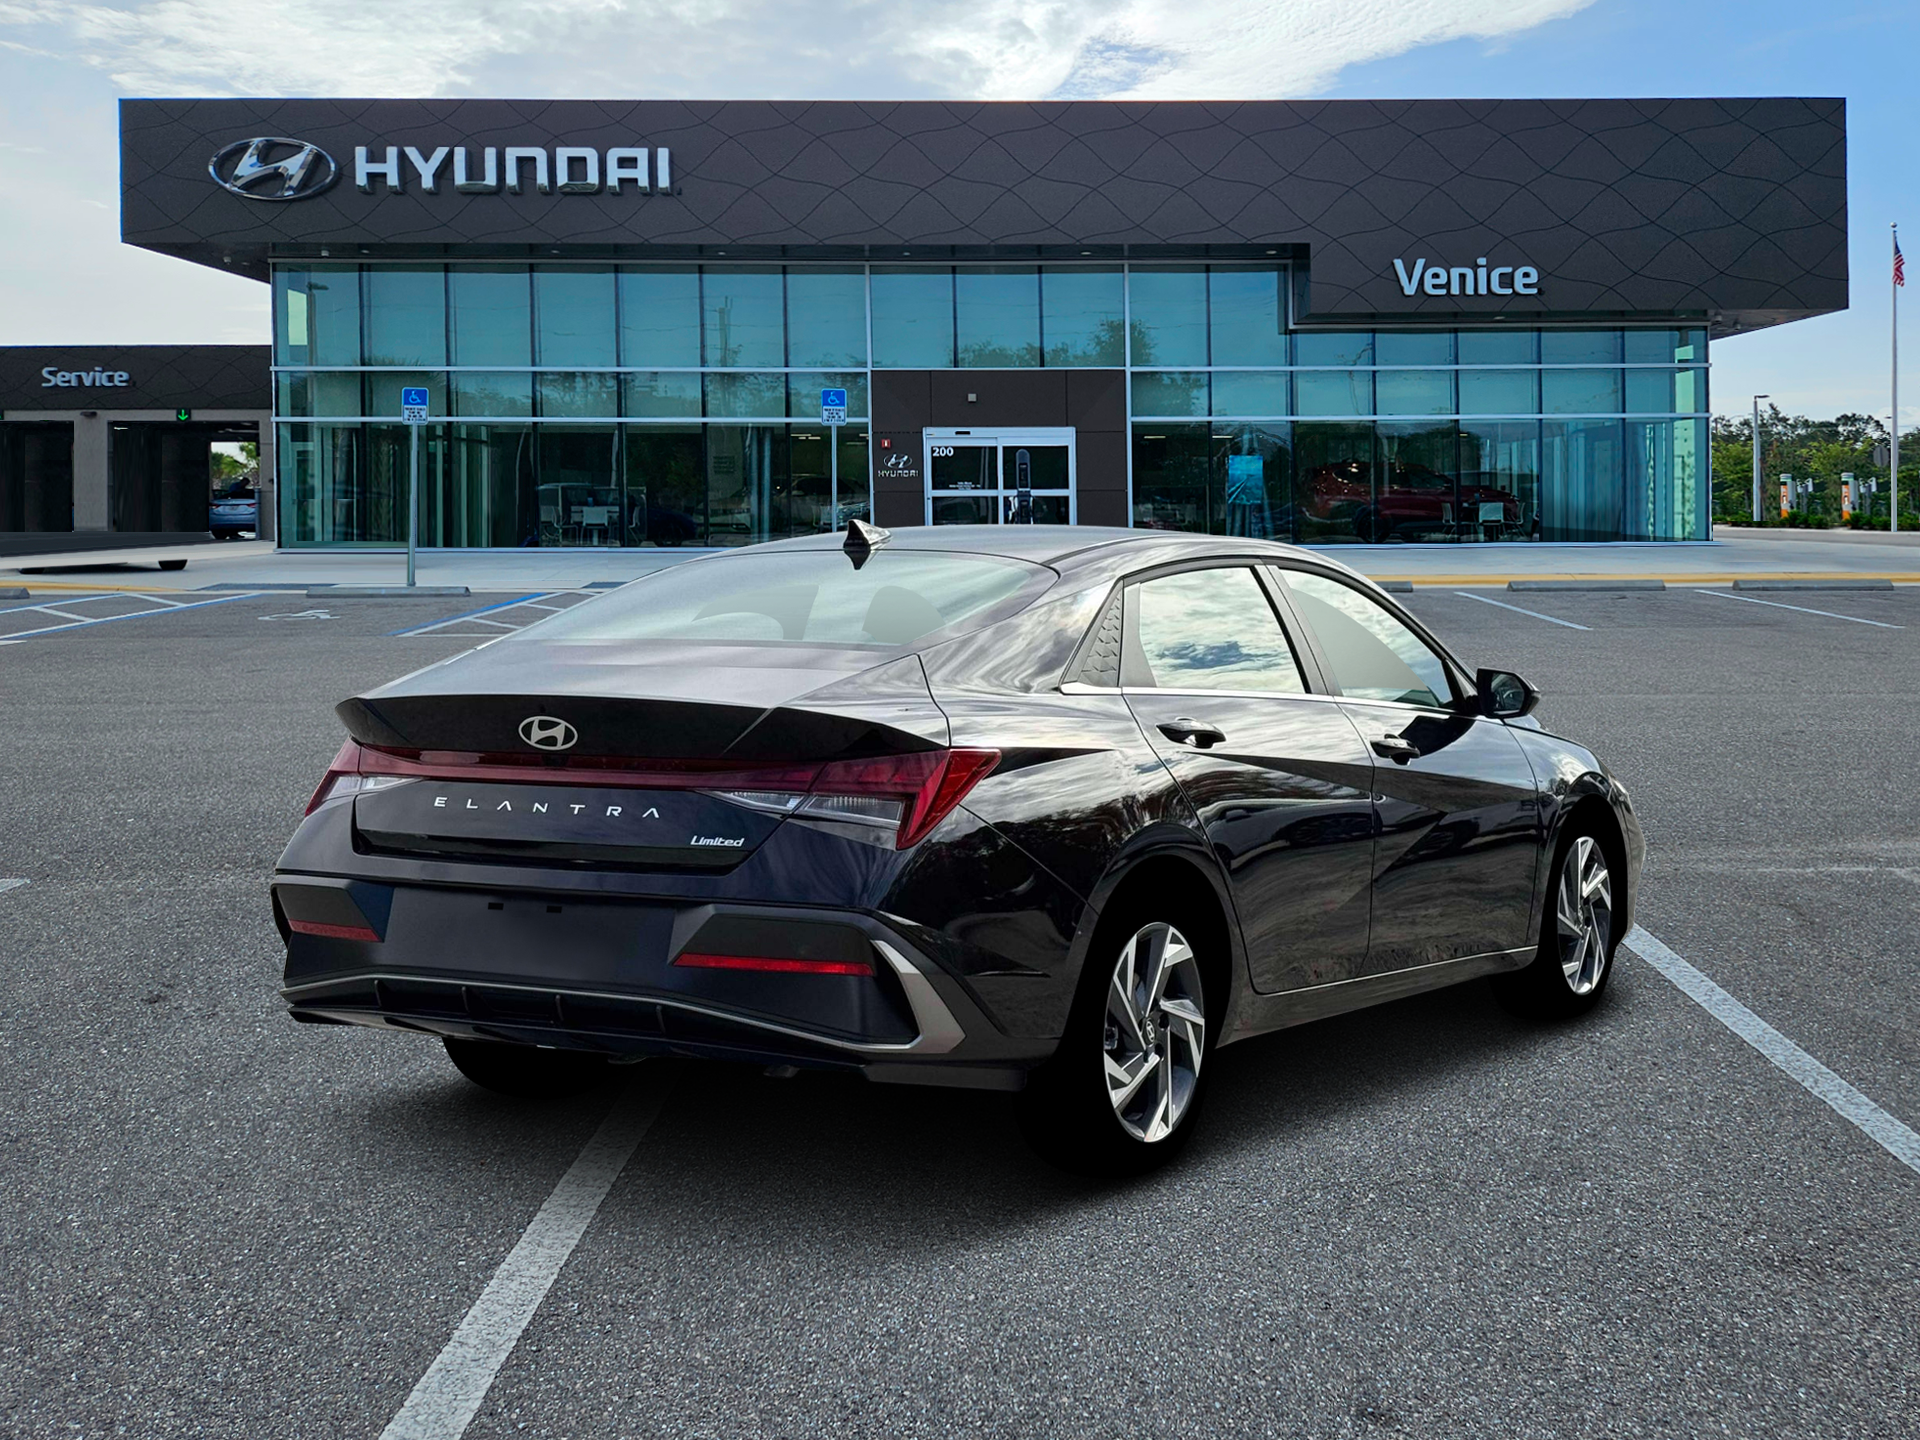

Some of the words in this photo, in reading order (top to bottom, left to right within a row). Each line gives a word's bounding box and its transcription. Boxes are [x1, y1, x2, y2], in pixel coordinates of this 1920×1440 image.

[354, 146, 671, 194] HYUNDAI
[1392, 257, 1539, 296] Venice
[41, 366, 130, 387] Service
[932, 446, 954, 457] 200
[877, 469, 919, 478] HYUNDAI
[433, 796, 660, 818] ELANTRA
[690, 835, 745, 847] Limited
